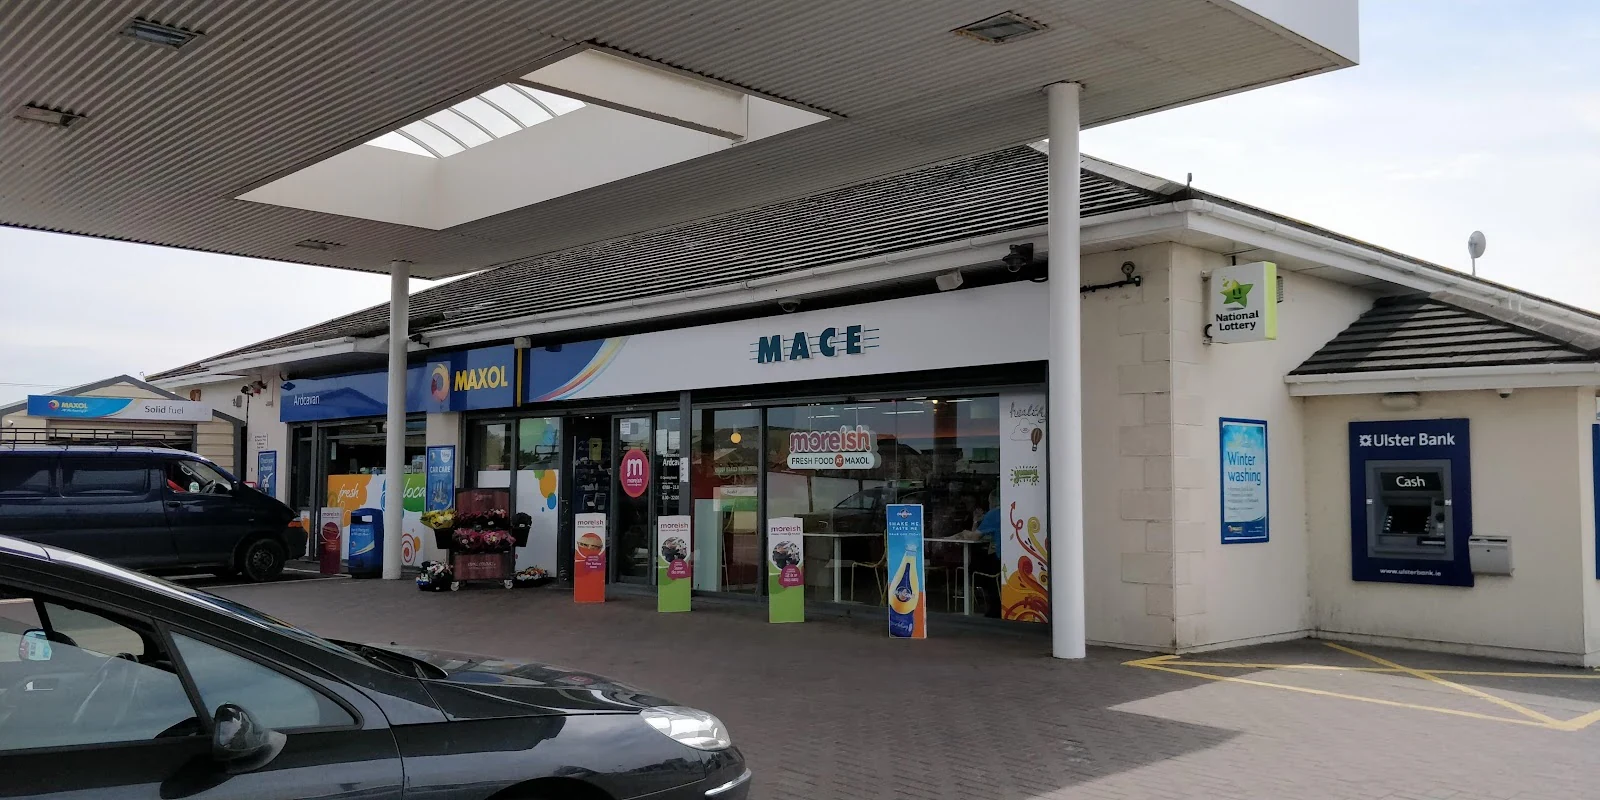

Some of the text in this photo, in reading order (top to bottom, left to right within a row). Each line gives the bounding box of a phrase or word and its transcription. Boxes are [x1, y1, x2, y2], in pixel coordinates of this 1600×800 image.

[1216, 310, 1259, 321] National
[1220, 321, 1256, 331] Lottery
[757, 325, 863, 364] MACE
[454, 366, 508, 391] MAXOL
[293, 394, 320, 406] Ardcavan
[144, 405, 184, 414] Solid fuel
[790, 425, 872, 452] moreish
[1373, 433, 1456, 447] Ulster Bank
[662, 458, 680, 467] Ardcav
[791, 457, 813, 465] FRESH
[814, 457, 834, 465] FOOD
[845, 456, 870, 465] MAXOL
[1227, 451, 1256, 466] Winter
[1227, 468, 1262, 486] washing
[1396, 476, 1426, 487] Cash
[337, 483, 359, 503] fresh
[402, 478, 426, 498] loca
[1379, 568, 1442, 577] www.ulsterbank.ie
